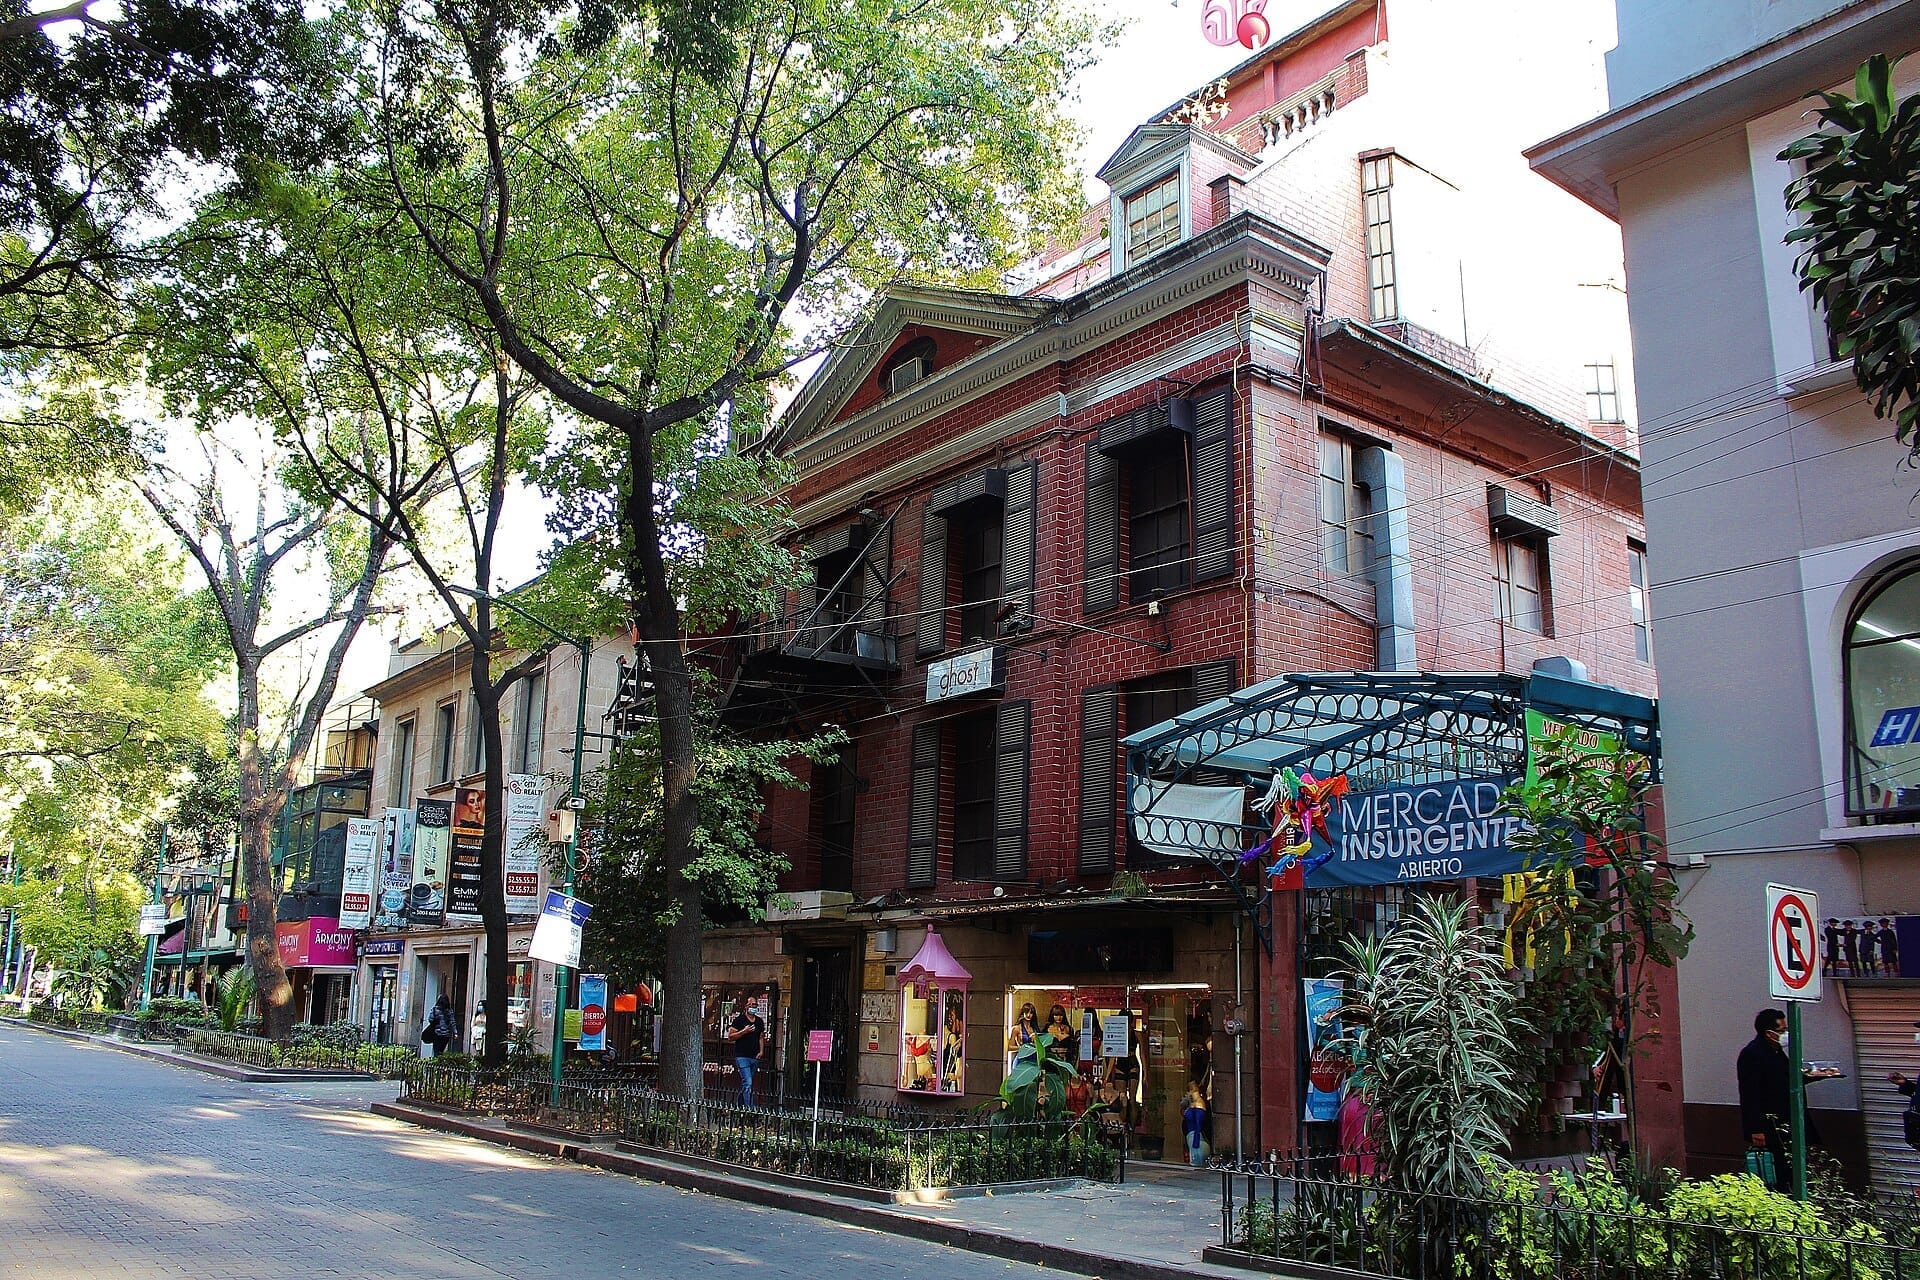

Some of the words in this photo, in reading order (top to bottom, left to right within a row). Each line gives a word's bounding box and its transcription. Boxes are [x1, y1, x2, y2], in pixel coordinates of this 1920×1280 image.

[940, 659, 979, 698] ghost
[1542, 719, 1600, 749] MERADO
[523, 788, 544, 796] REALTY
[524, 780, 537, 789] CITY
[1285, 827, 1296, 870] BIEO
[1397, 857, 1463, 879] ABIERTO
[584, 1012, 605, 1020] BIERTO
